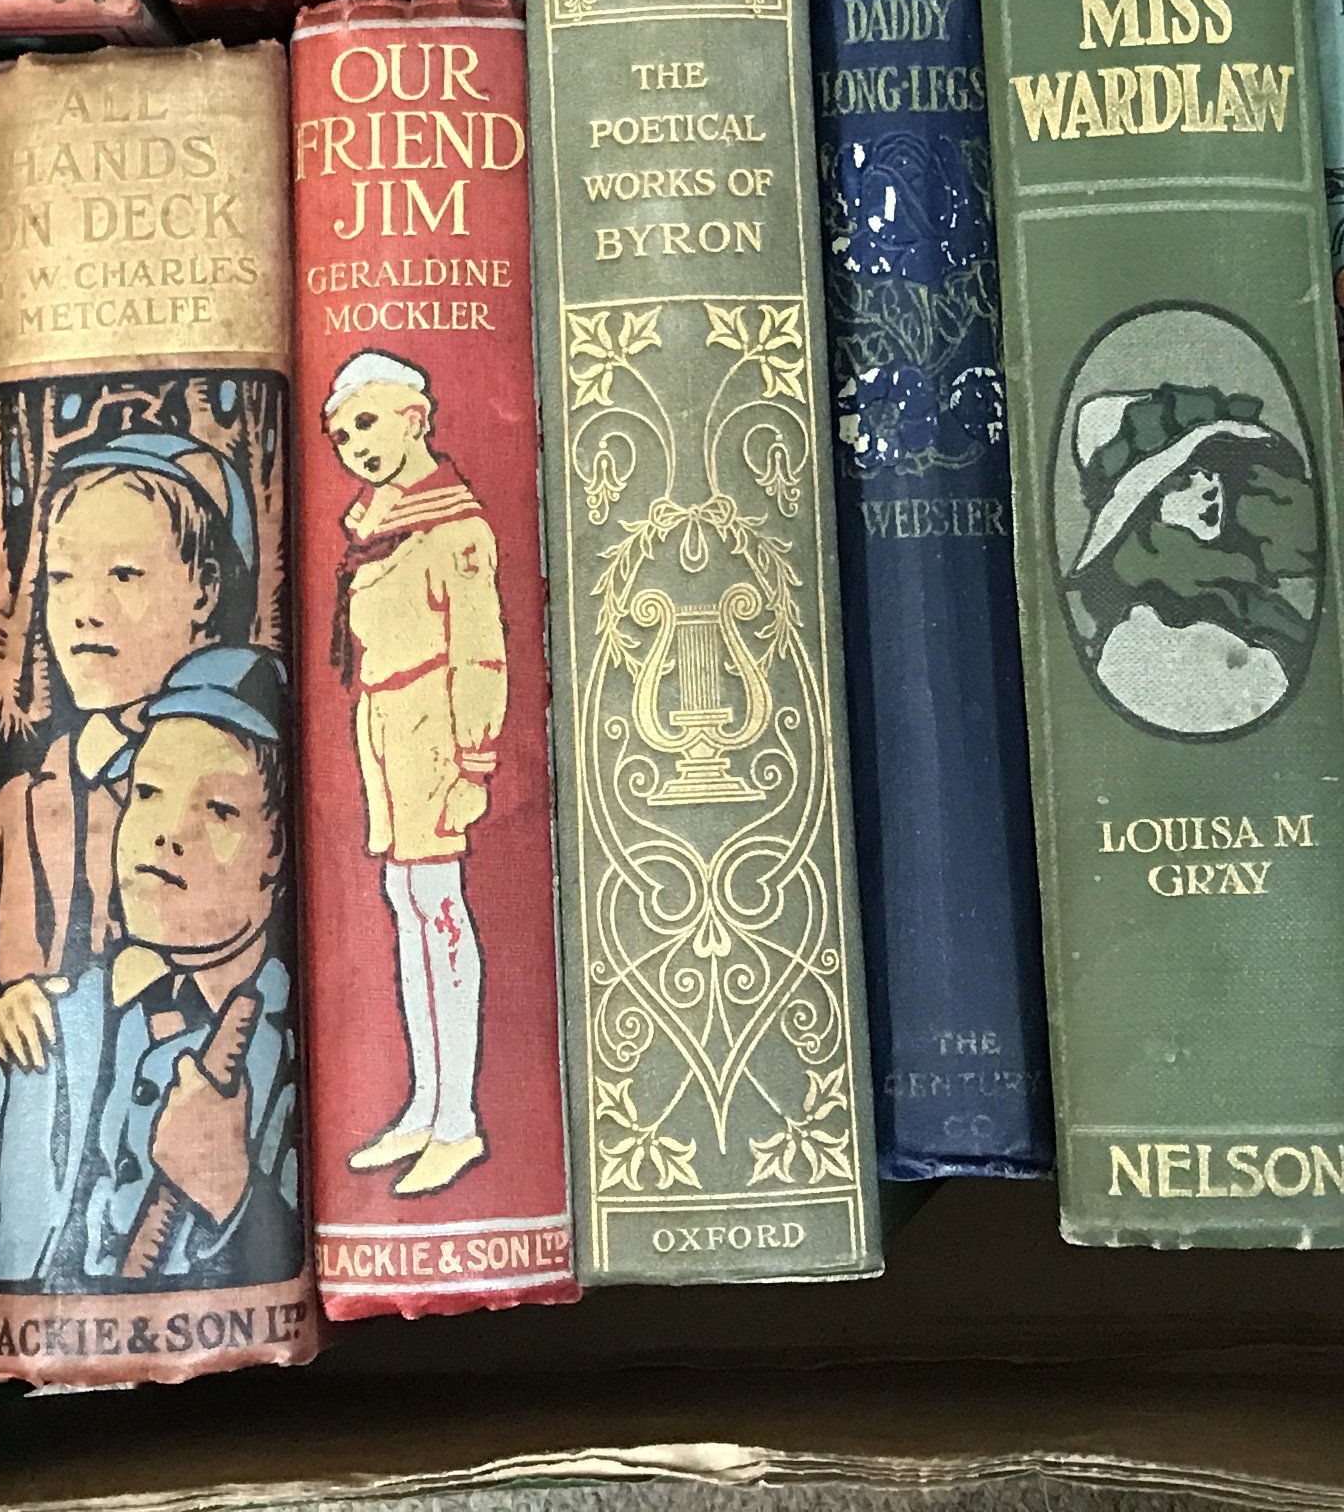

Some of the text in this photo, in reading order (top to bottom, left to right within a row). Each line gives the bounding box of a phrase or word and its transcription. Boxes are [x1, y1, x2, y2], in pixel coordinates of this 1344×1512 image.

[330, 43, 491, 104] OUR
[630, 61, 710, 91] THE
[54, 83, 170, 126] ALL
[1009, 61, 1296, 143] WARDLAW
[294, 110, 526, 181] FRIEND
[589, 113, 768, 149] POETICAL
[11, 133, 218, 187] HANDS
[581, 167, 775, 203] WORKS OF
[80, 192, 245, 244] DECK
[332, 179, 471, 240] JIM
[594, 220, 766, 261] BYRON
[73, 256, 259, 290] CHARLES
[306, 257, 514, 295] GERALDINE
[18, 294, 214, 335] METCALFE
[323, 300, 497, 337] MOCKLER
[859, 496, 1008, 539] WEBSTER
[1096, 815, 1265, 854] LOUISA
[1147, 860, 1273, 897] GRAY
[931, 1029, 1003, 1057] THE
[437, 1239, 464, 1272] &
[467, 1236, 530, 1270] SON
[651, 1221, 807, 1254] OXFORD
[127, 1316, 157, 1352] &
[165, 1311, 256, 1350] SON
